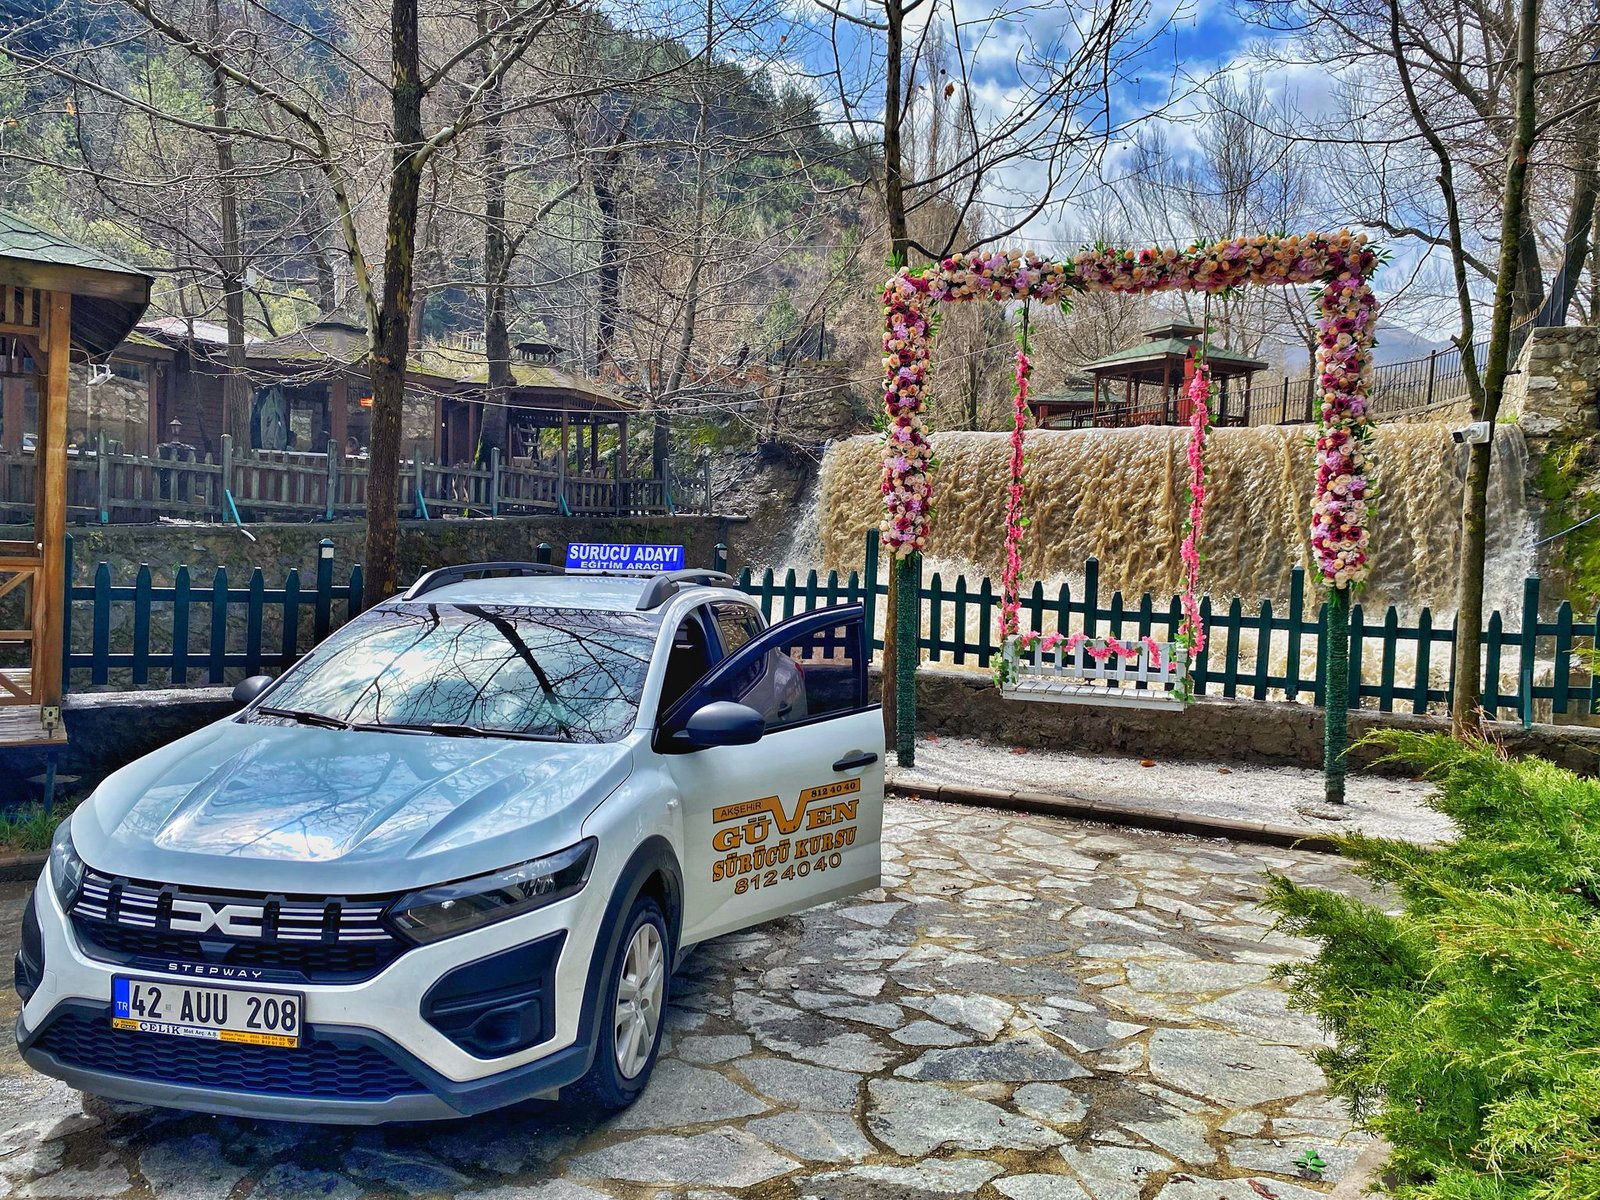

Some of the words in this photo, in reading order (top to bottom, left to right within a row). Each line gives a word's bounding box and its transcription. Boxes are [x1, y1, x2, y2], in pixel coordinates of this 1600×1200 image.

[569, 543, 631, 561] SÜRÜCÜ
[634, 547, 678, 562] ADAYI
[580, 560, 623, 570] EĞİTİM
[811, 789, 828, 798] 812
[830, 784, 842, 794] 40
[844, 782, 856, 791] 40
[712, 796, 860, 851] GÜVEN
[712, 838, 791, 882] SÜRÜCÜ
[794, 826, 858, 860] KURSU
[168, 963, 262, 979] STEPWAY
[116, 1000, 129, 1012] TR
[131, 984, 162, 1019] 42
[180, 990, 228, 1025] AUU
[246, 996, 297, 1032] 208
